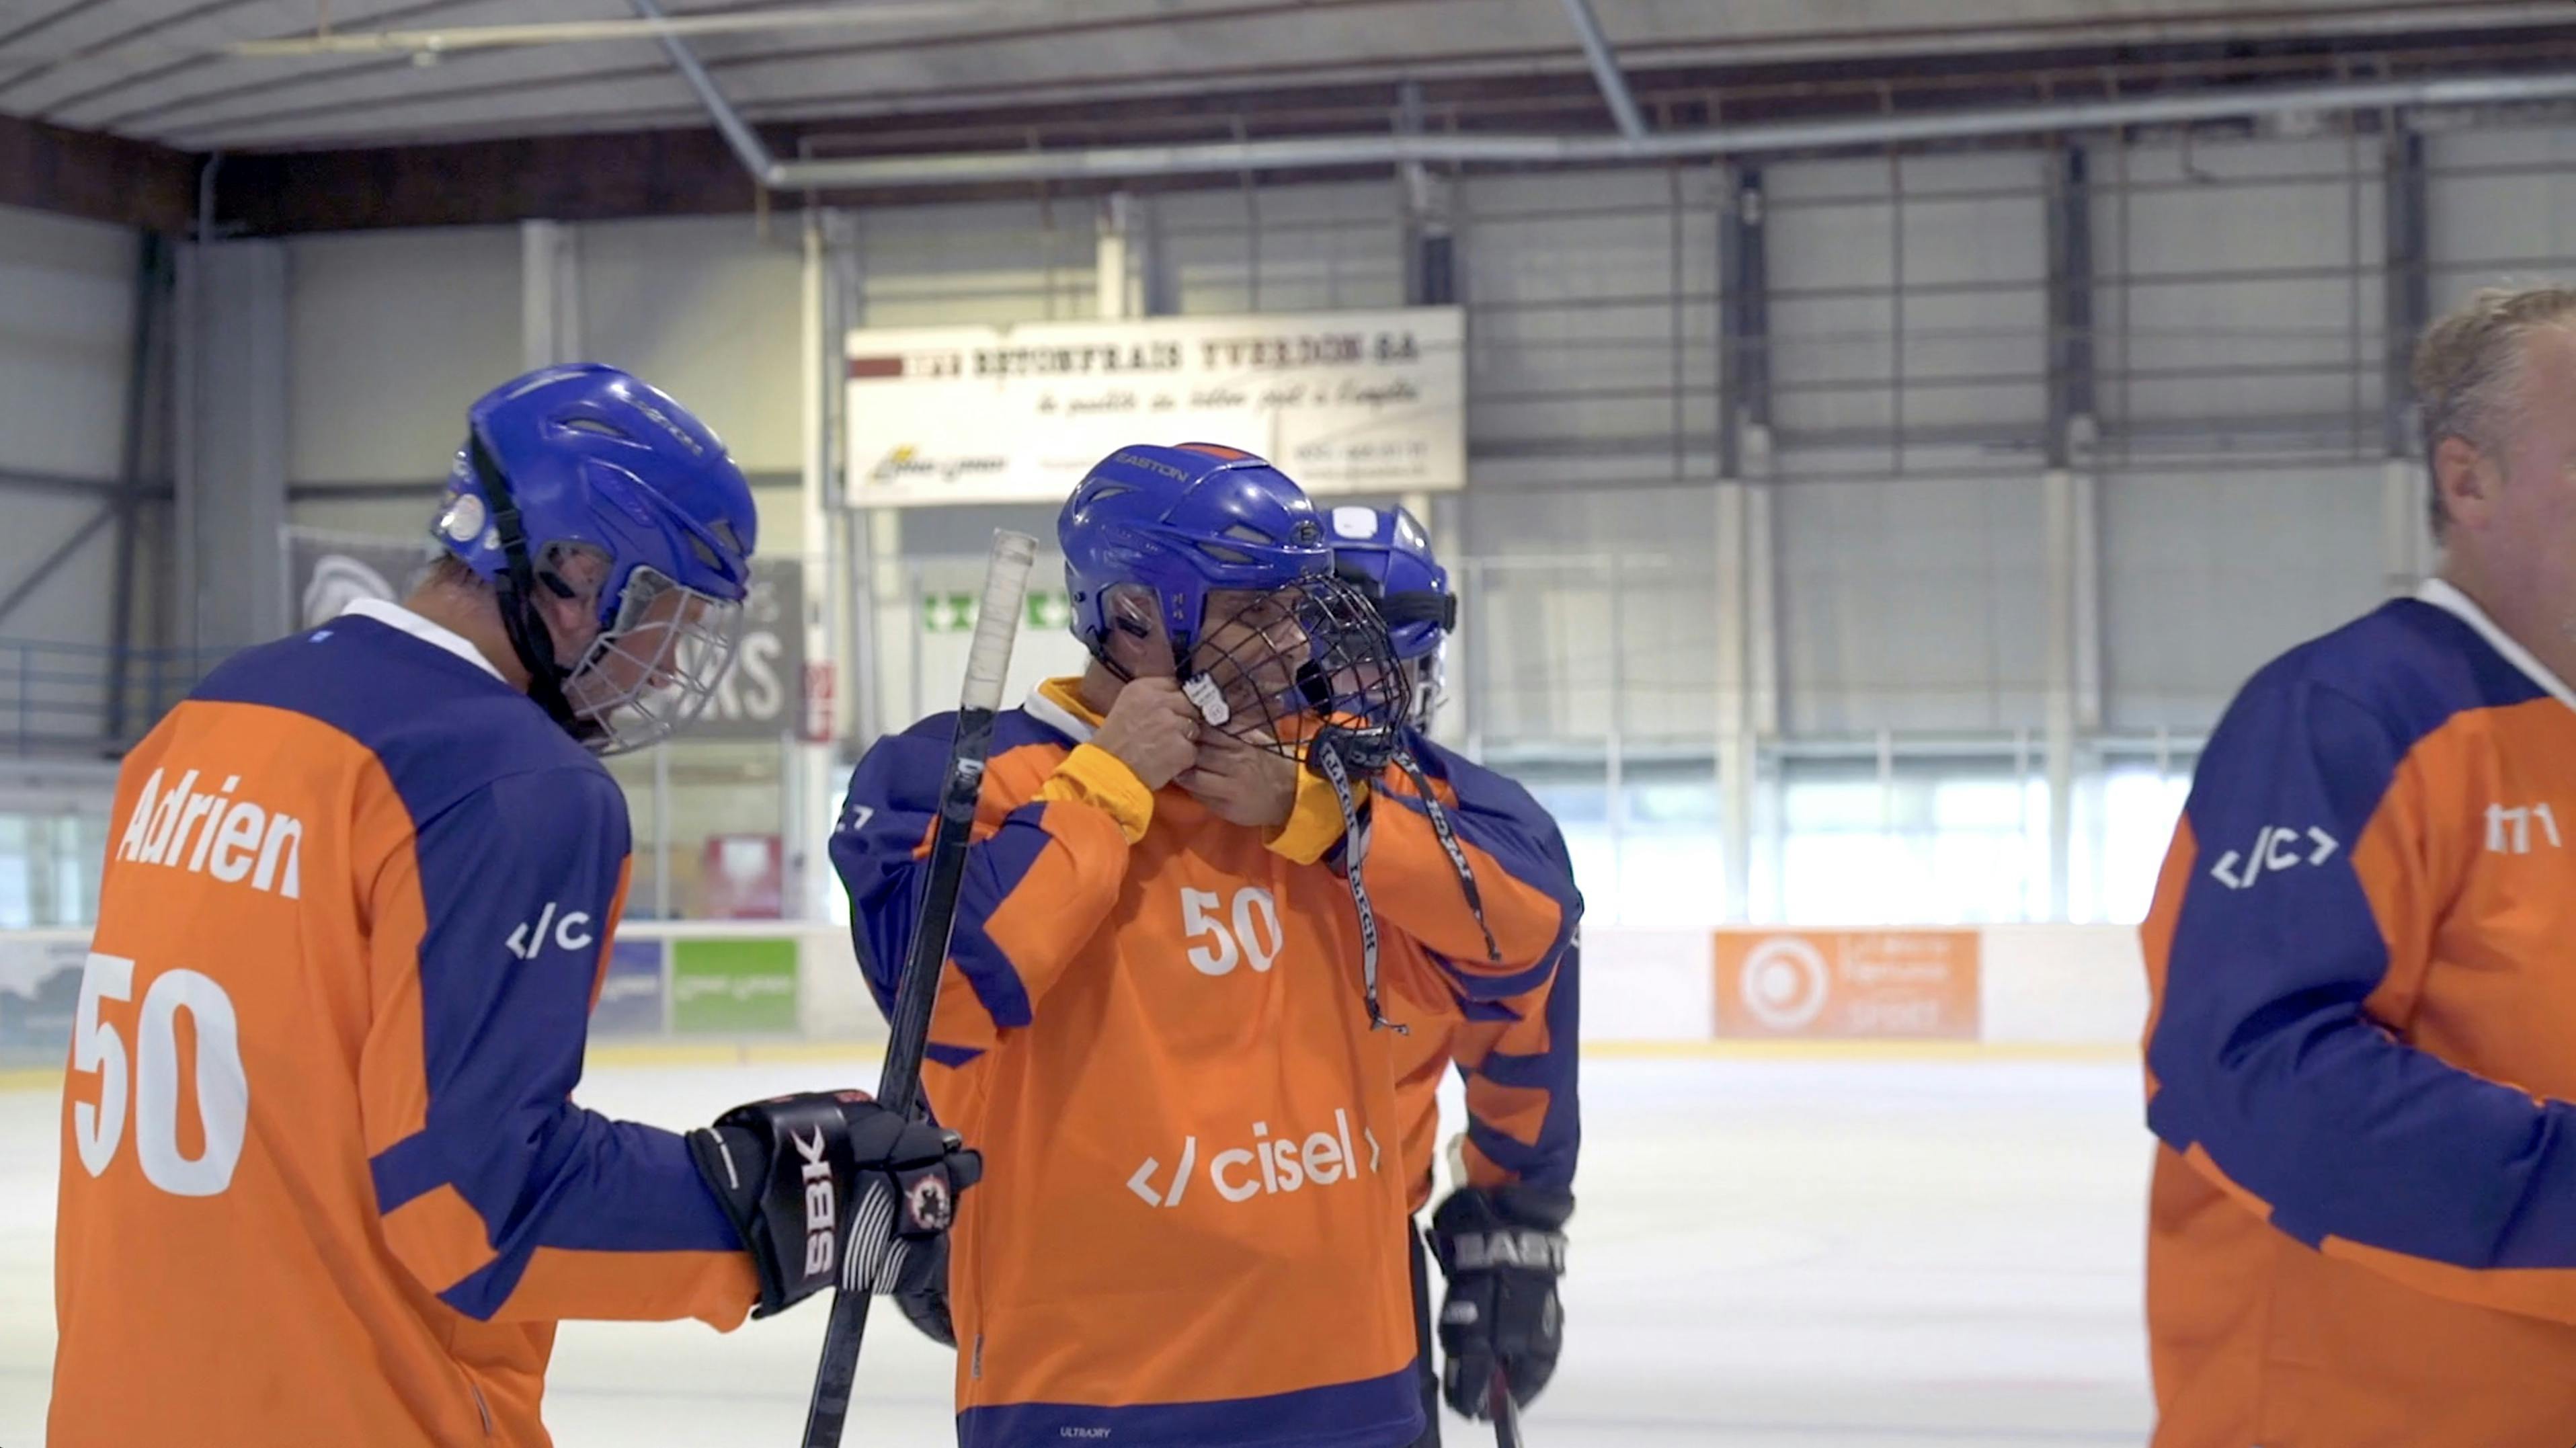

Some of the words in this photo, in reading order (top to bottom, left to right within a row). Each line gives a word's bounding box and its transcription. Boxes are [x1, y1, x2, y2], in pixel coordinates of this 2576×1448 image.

[1117, 452, 1189, 483] EASTON
[116, 767, 302, 899] Adrien
[1180, 887, 1283, 976] 50
[73, 952, 249, 1197] 50
[789, 1123, 836, 1278] SBK
